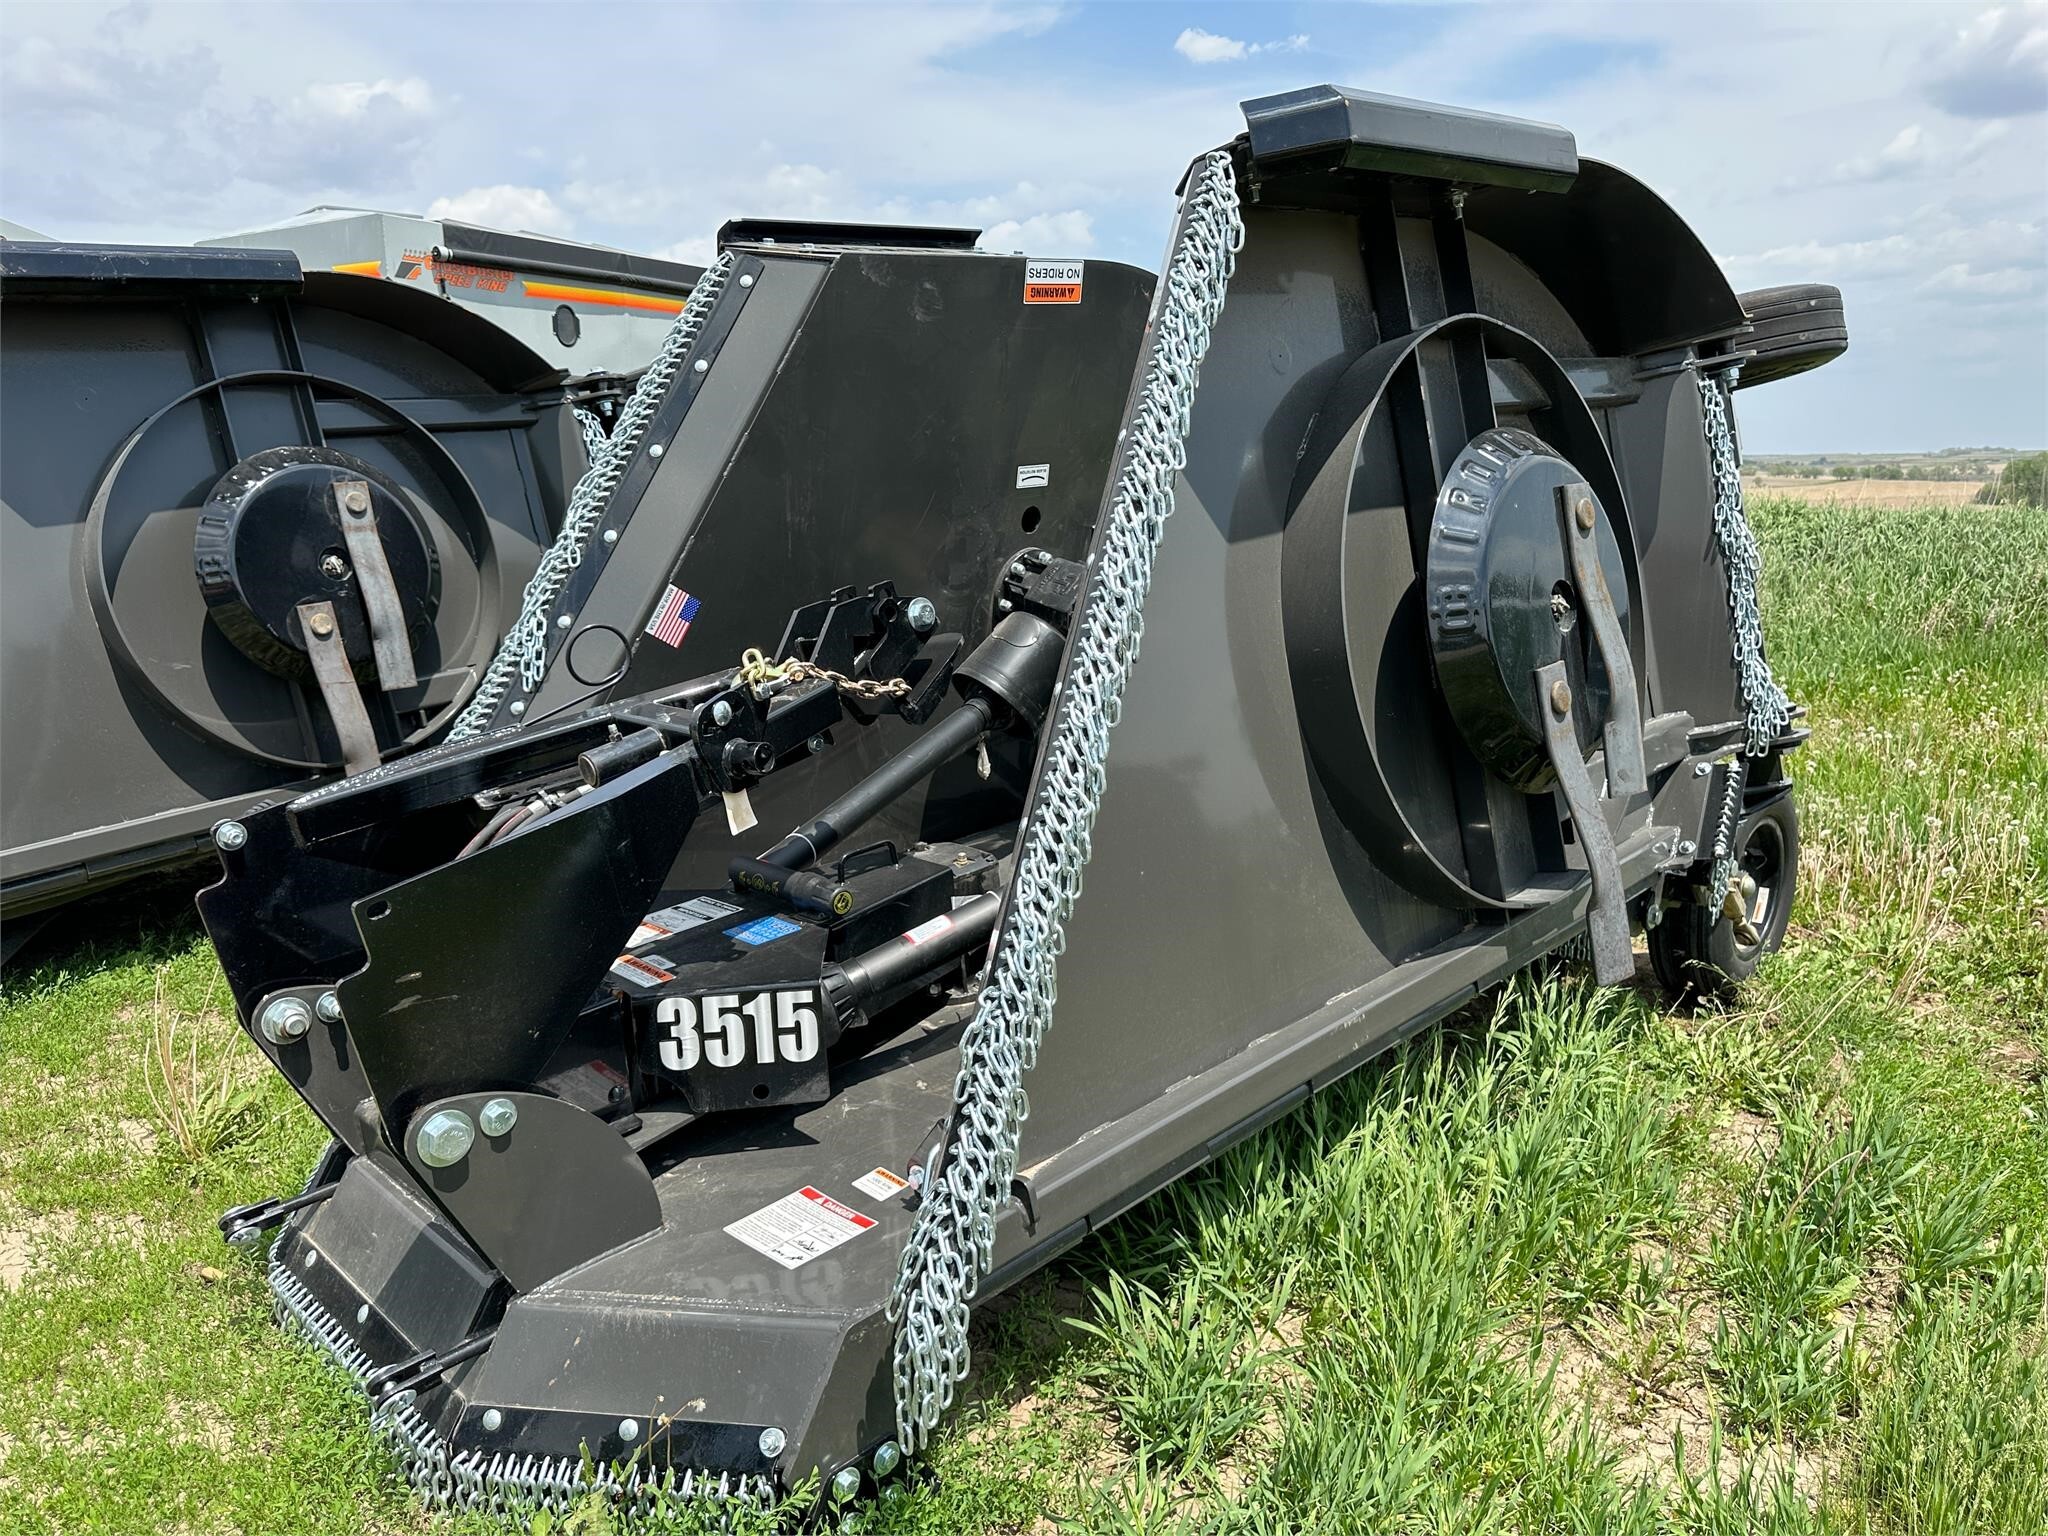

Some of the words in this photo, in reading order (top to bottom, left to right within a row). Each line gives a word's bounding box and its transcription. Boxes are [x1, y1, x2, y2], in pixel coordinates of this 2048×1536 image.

[1029, 268, 1064, 279] RIDERS
[1067, 268, 1080, 279] NO
[477, 278, 507, 293] KING
[1031, 287, 1066, 298] WARNING
[629, 959, 666, 979] WARNING
[656, 990, 819, 1071] 3515
[823, 1202, 855, 1219] DANGER
